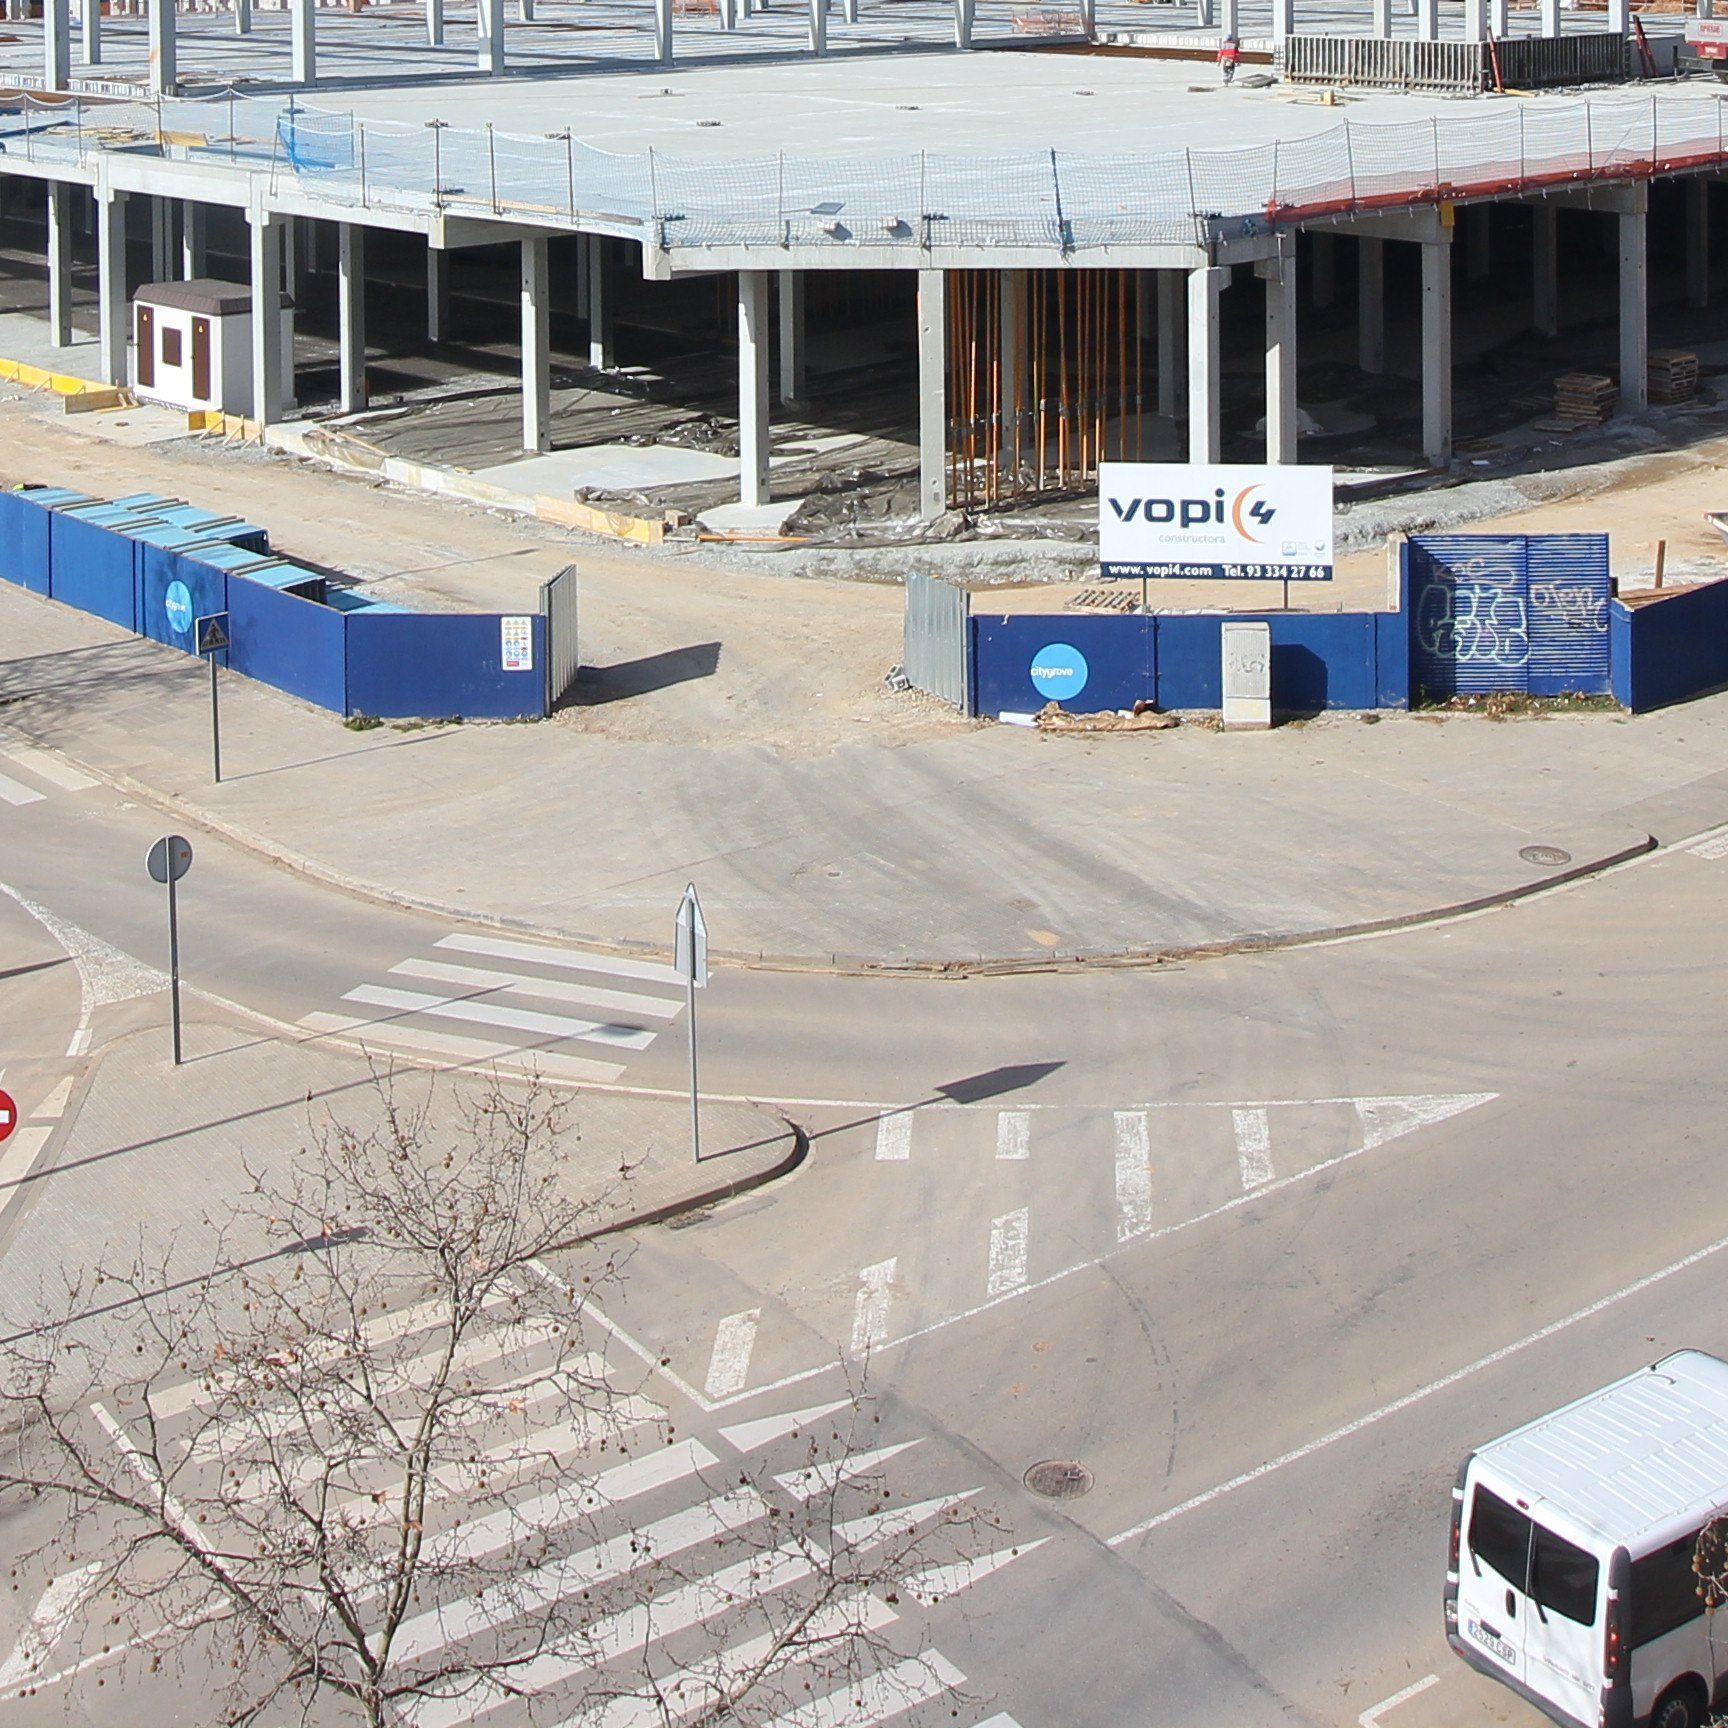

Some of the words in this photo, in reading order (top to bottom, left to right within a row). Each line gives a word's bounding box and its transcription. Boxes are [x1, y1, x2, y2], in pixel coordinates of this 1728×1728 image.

[1158, 533, 1226, 545] constructora
[1221, 564, 1245, 577] Tel.
[1246, 565, 1262, 577] 93
[1265, 565, 1287, 578] 334
[1290, 566, 1306, 578] 27
[1309, 566, 1325, 578] 66
[1030, 665, 1073, 679] citygrove
